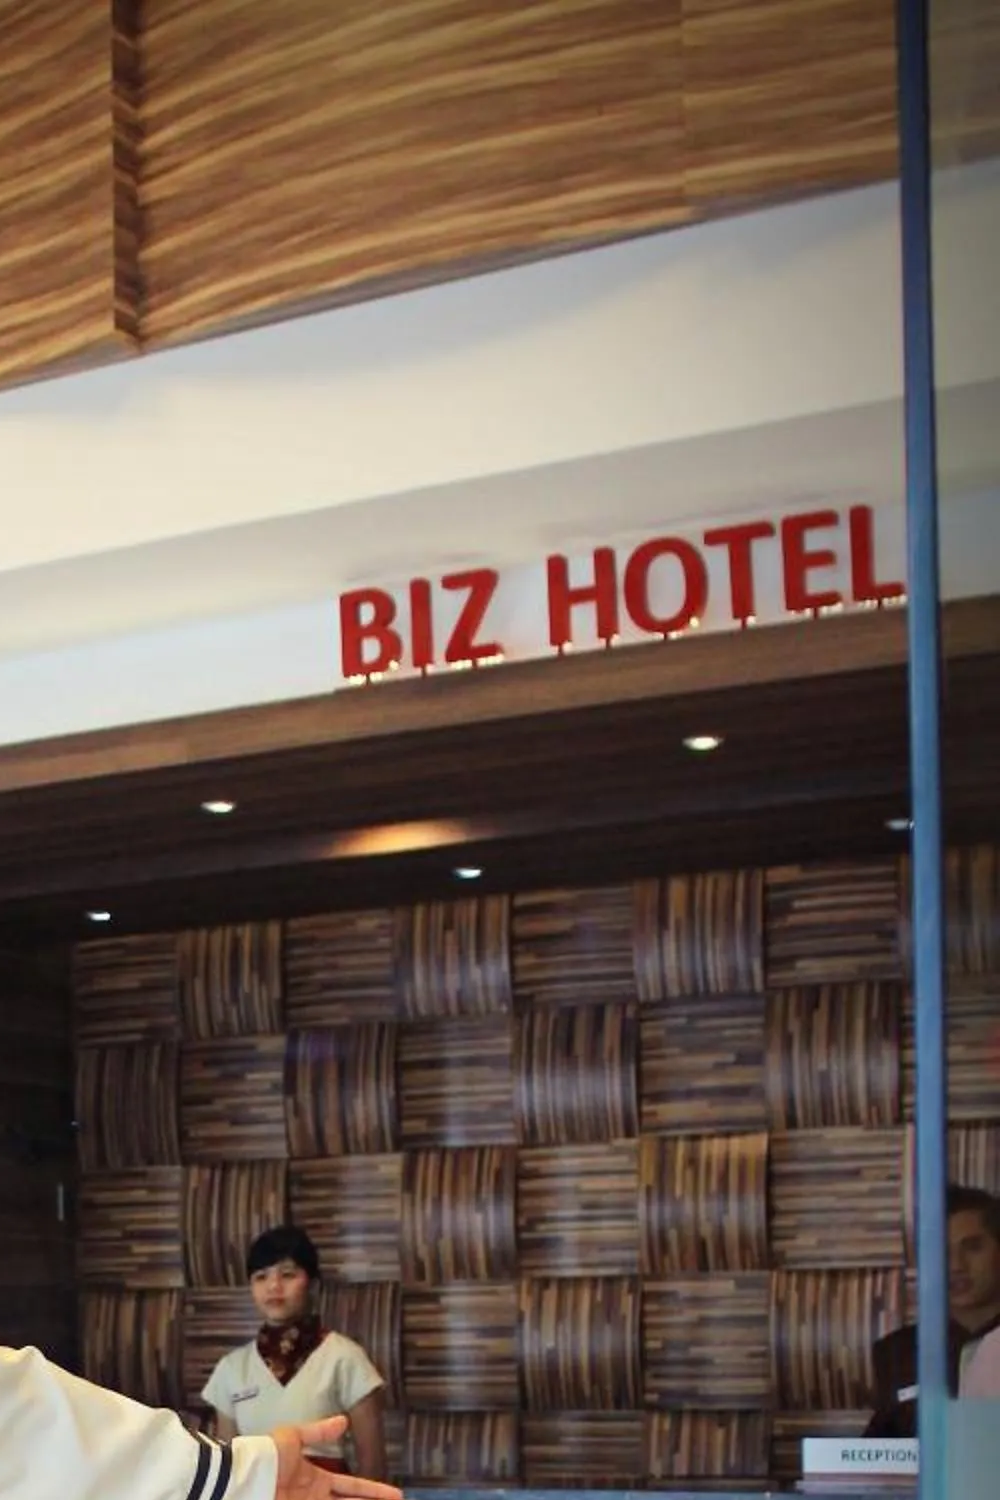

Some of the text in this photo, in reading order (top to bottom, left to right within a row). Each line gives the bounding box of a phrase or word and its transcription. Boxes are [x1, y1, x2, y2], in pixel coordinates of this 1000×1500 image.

[340, 505, 906, 680] BIZ HOTEL
[841, 1449, 917, 1462] RECEPTION
